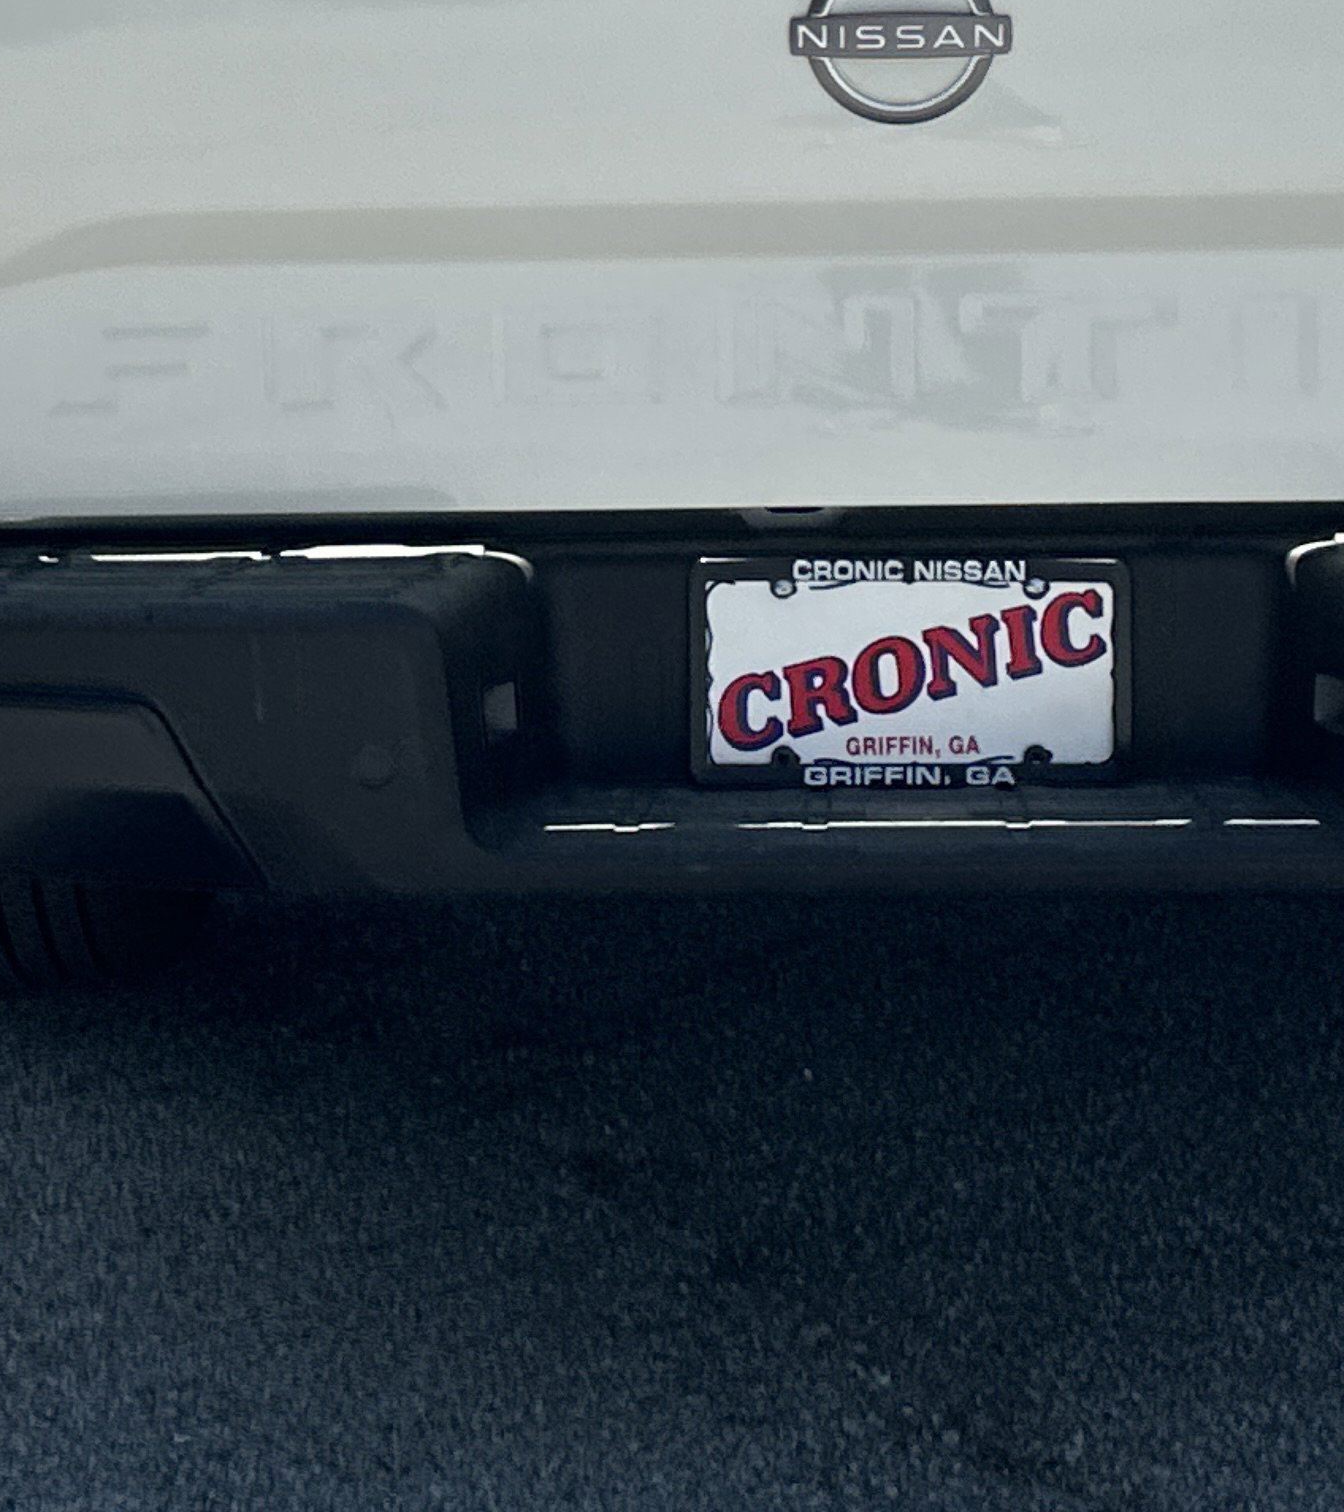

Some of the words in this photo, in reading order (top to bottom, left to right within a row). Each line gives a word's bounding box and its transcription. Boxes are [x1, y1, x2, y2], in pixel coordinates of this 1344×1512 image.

[796, 24, 1005, 49] NISSAN
[792, 559, 904, 581] CRONIC
[914, 559, 1026, 581] NISSAN
[718, 589, 1107, 751] CRONIC
[846, 736, 941, 758] GRIFFIN,
[948, 736, 981, 756] GA
[803, 766, 952, 787] GRIFFIN,
[965, 766, 1016, 786] GA
